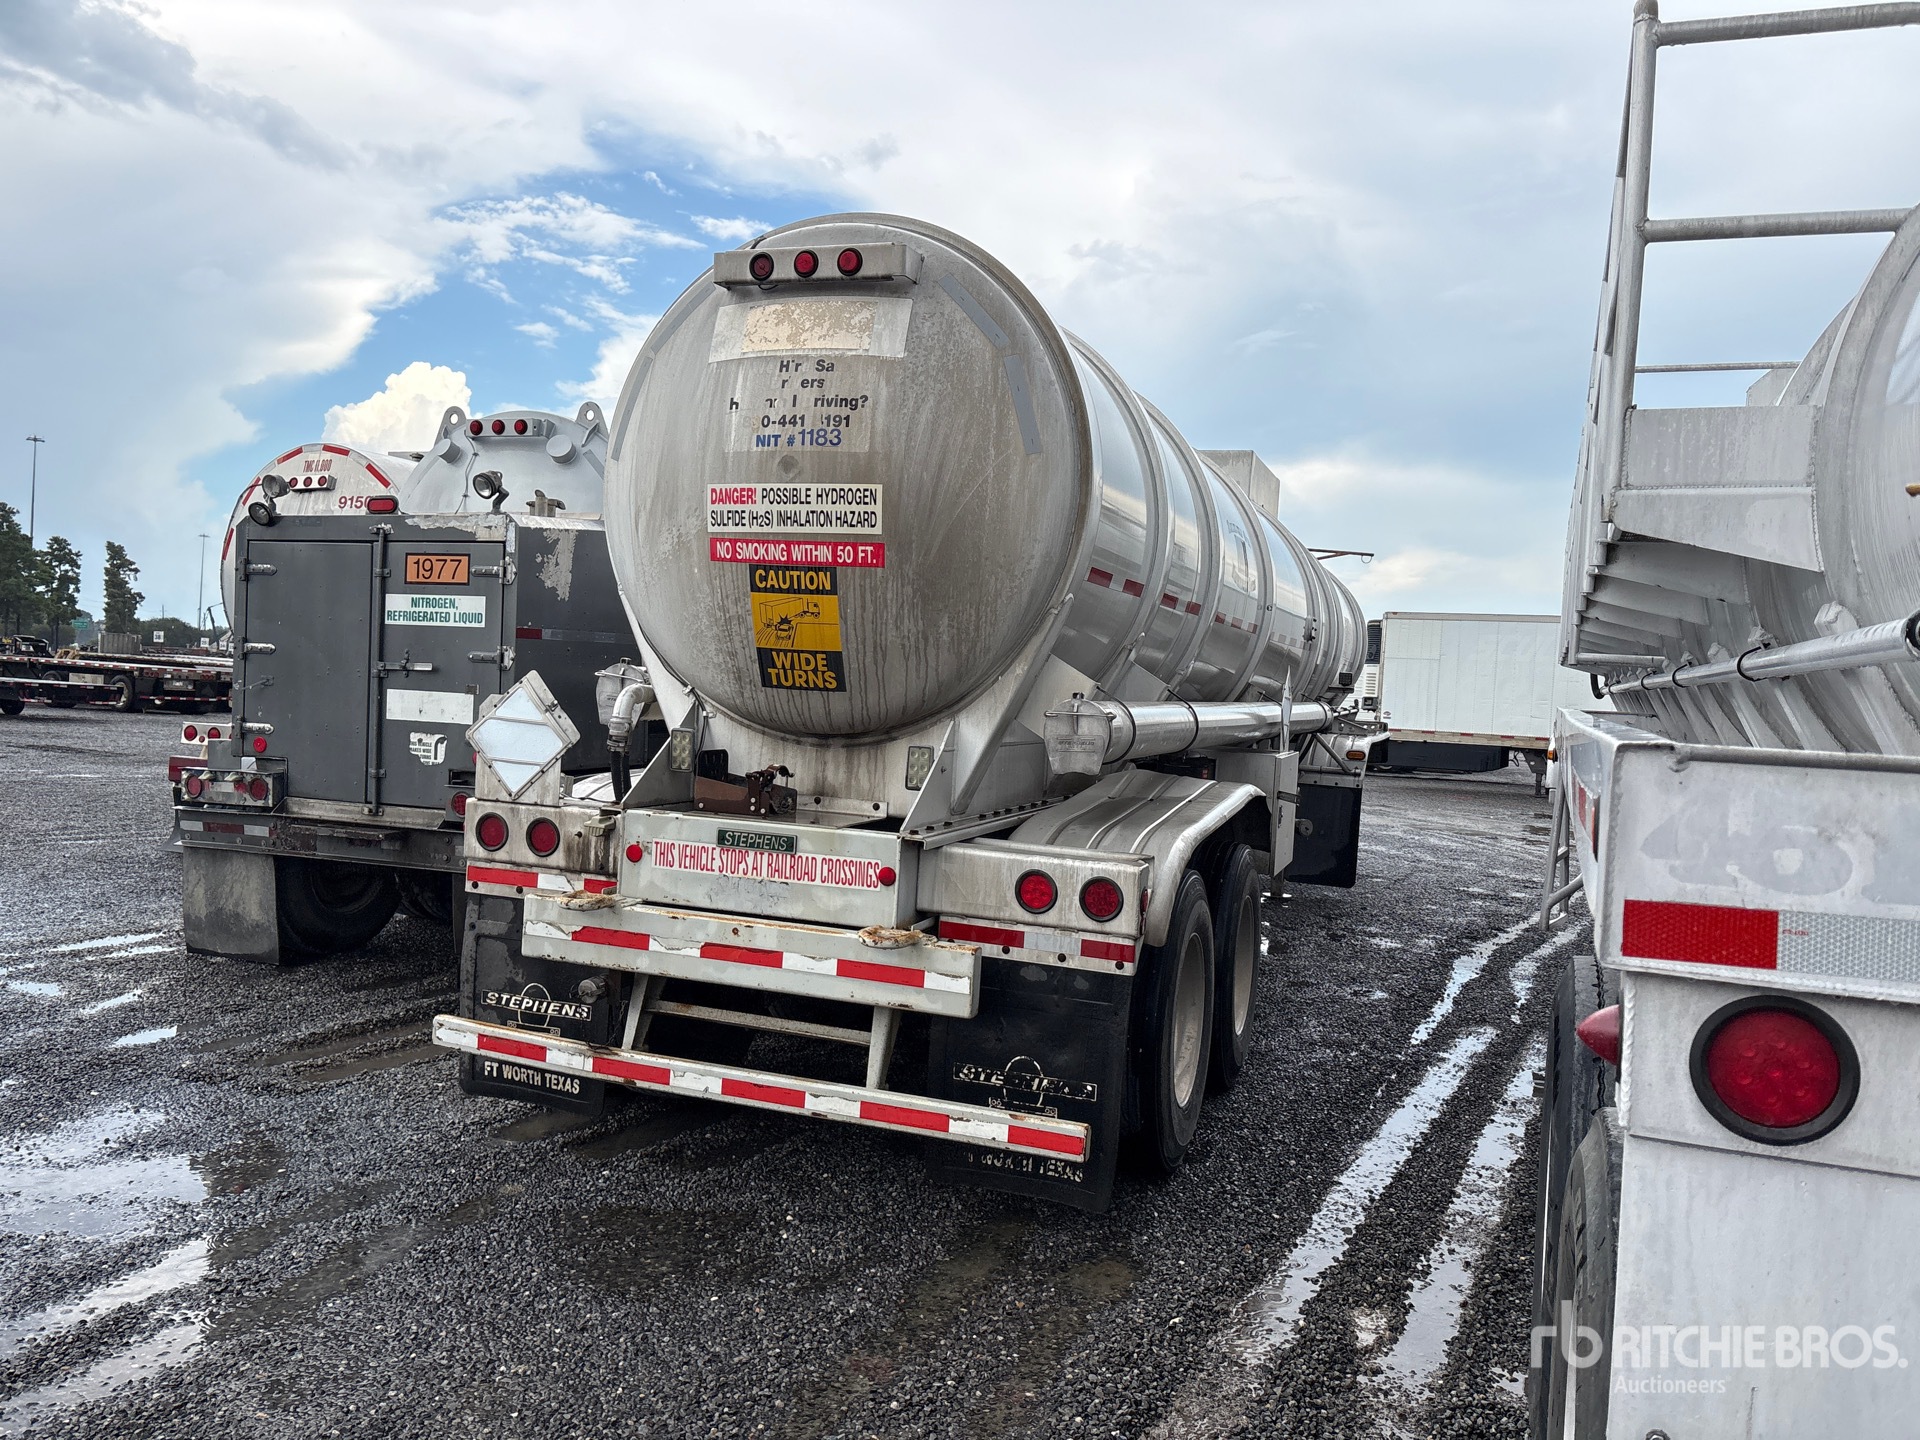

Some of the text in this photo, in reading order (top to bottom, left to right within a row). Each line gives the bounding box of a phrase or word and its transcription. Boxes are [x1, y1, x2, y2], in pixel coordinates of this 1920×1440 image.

[814, 394, 869, 411] riving?
[755, 433, 782, 447] NIT
[710, 487, 878, 506] DANGER! POSSIBLE HYDROGEN
[710, 509, 747, 527] SULFIDE
[776, 510, 833, 528] INHALATION
[835, 510, 878, 529] HAZARD
[716, 541, 877, 564] NO SMOKING WITHIN 50 FT.
[413, 558, 462, 580] 1977
[755, 569, 831, 591] CAUTION
[410, 596, 459, 611] NITROGEN,
[386, 610, 483, 625] REFRIGERATED LIQUID
[771, 651, 828, 671] WIDE
[767, 668, 838, 689] TURNS
[724, 831, 788, 851] STEPHENS
[654, 841, 880, 889] THIS VEHICLE STOPS AT RAILROAD CROSSINGS
[485, 991, 589, 1019] STEPHENS
[484, 1060, 581, 1095] FT WORTH TEXAS
